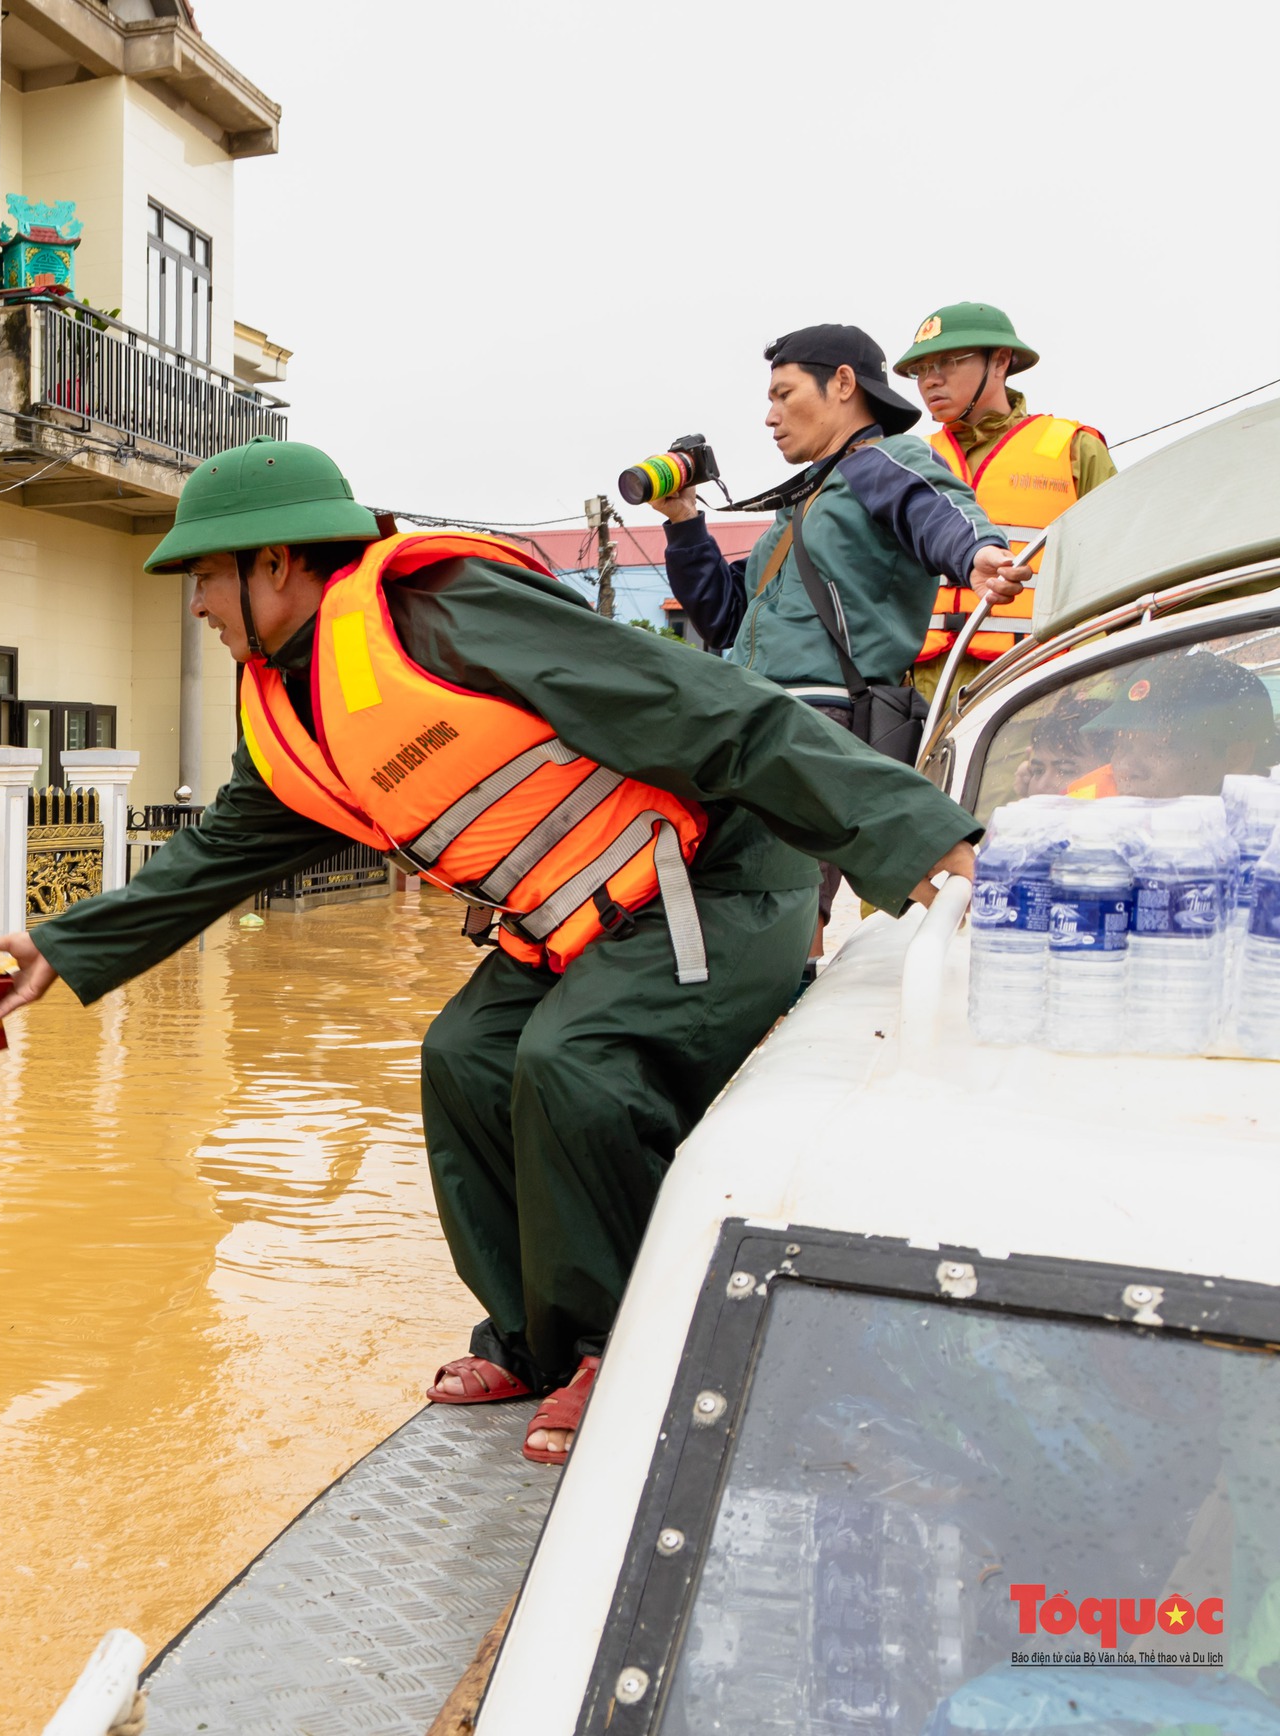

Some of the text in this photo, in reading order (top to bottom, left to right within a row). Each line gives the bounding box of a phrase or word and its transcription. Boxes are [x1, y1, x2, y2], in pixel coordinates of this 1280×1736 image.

[790, 481, 815, 501] SONY
[370, 767, 398, 793] BỘ
[395, 742, 428, 771] BIÊN
[415, 720, 460, 755] PHÒNG
